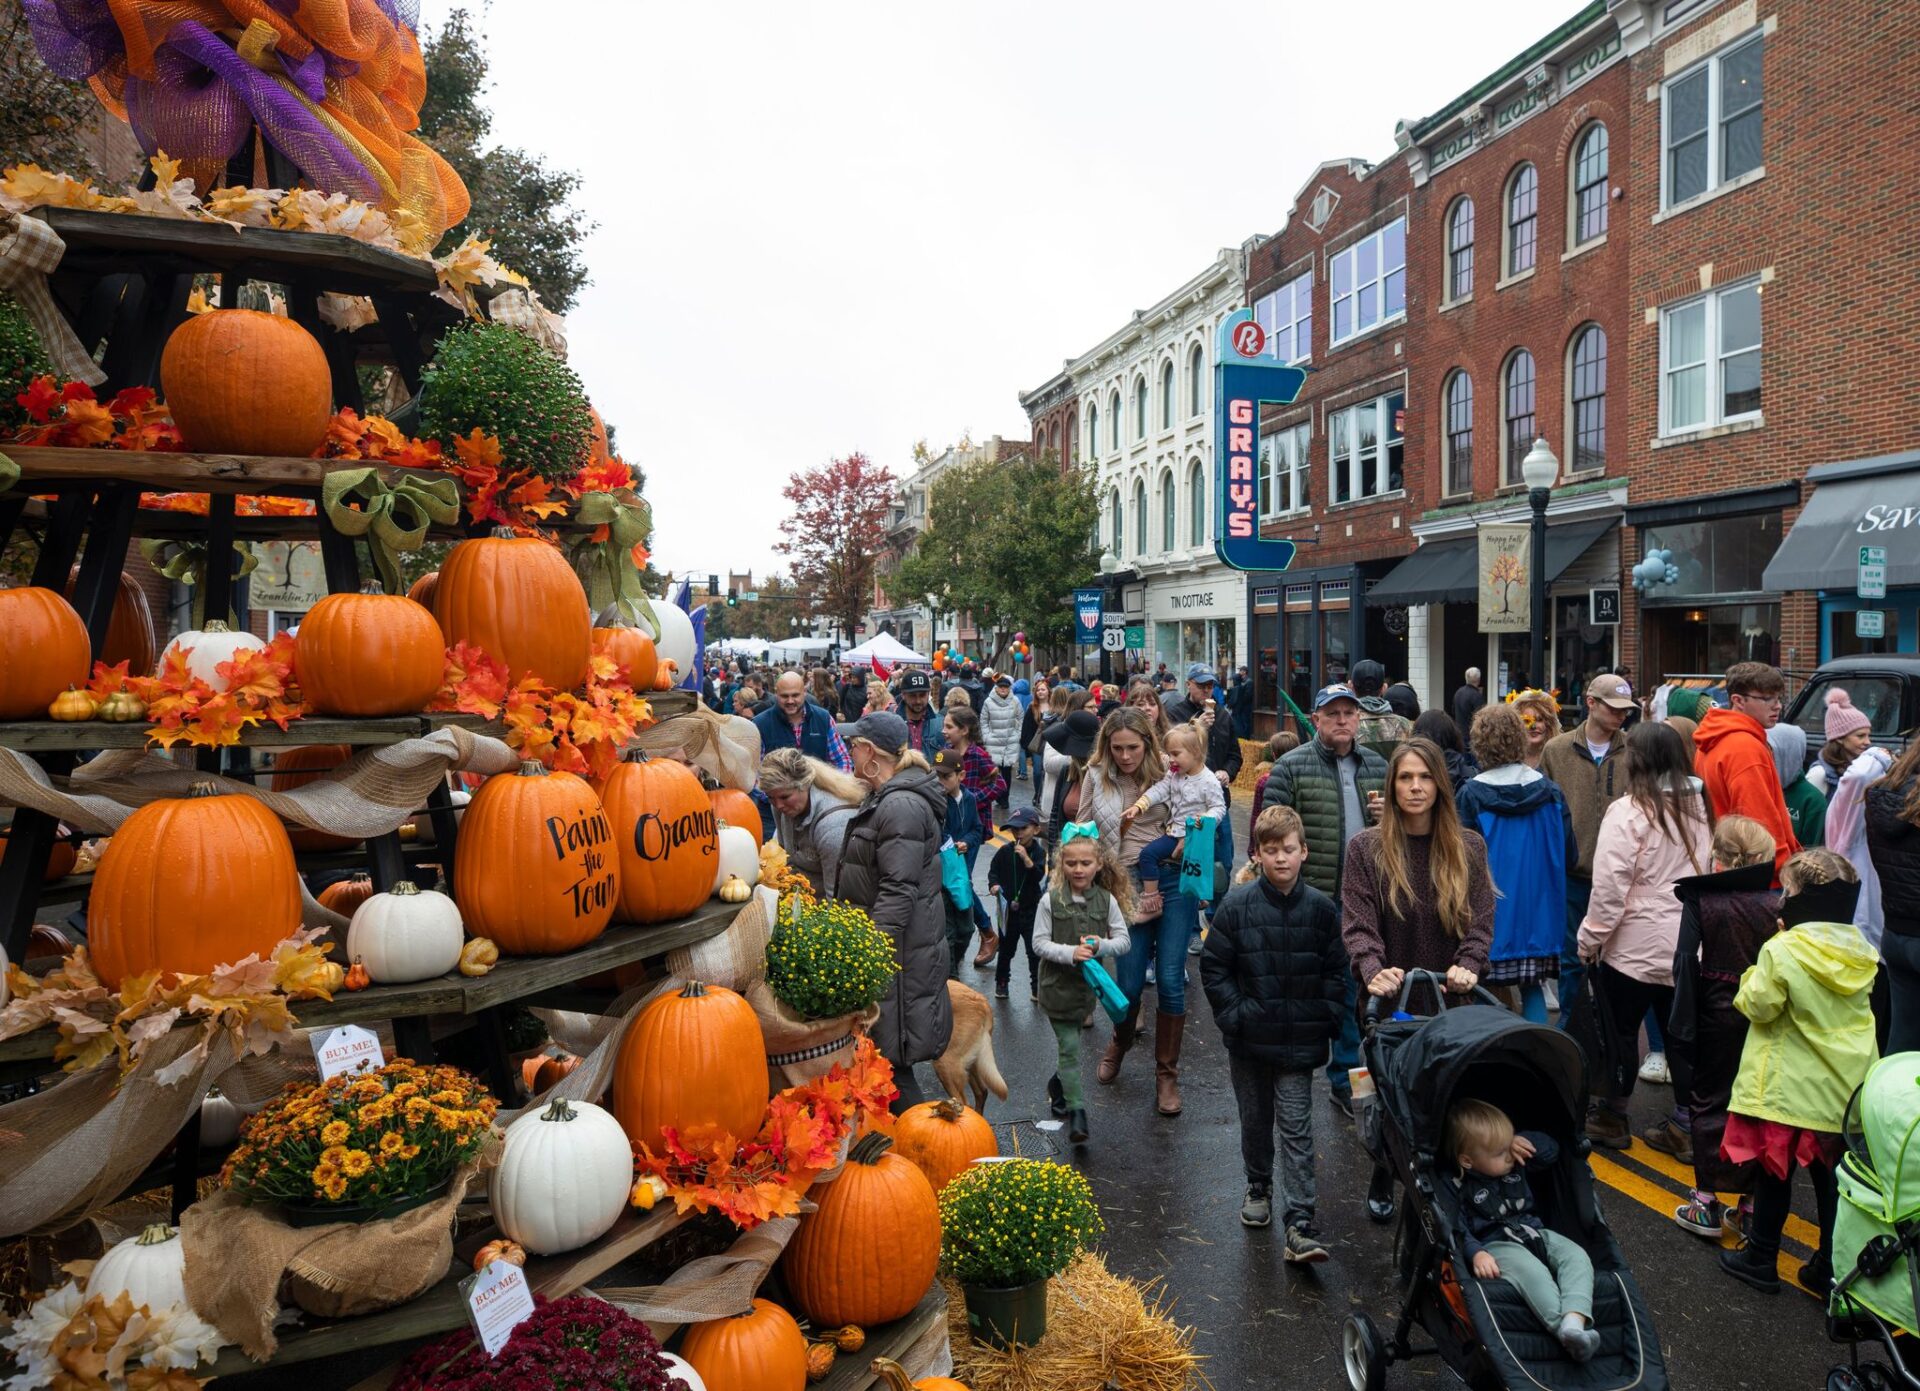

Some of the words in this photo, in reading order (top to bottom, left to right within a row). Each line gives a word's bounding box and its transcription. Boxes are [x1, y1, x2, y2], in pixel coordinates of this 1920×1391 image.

[1229, 399, 1256, 537] GRAY'S
[1856, 504, 1920, 533] Sav
[1861, 550, 1868, 564] 2
[1077, 593, 1100, 603] Welcome
[1171, 596, 1181, 608] TIN
[1182, 592, 1214, 608] COTTAGE
[1103, 614, 1125, 623] SOUTH
[1107, 632, 1121, 646] 31
[911, 676, 924, 685] SD
[579, 849, 605, 877] the
[562, 873, 616, 918] Town
[325, 1045, 349, 1060] BUY
[351, 1039, 374, 1053] ME!
[475, 1285, 497, 1306] BUY
[498, 1271, 519, 1290] ME!
